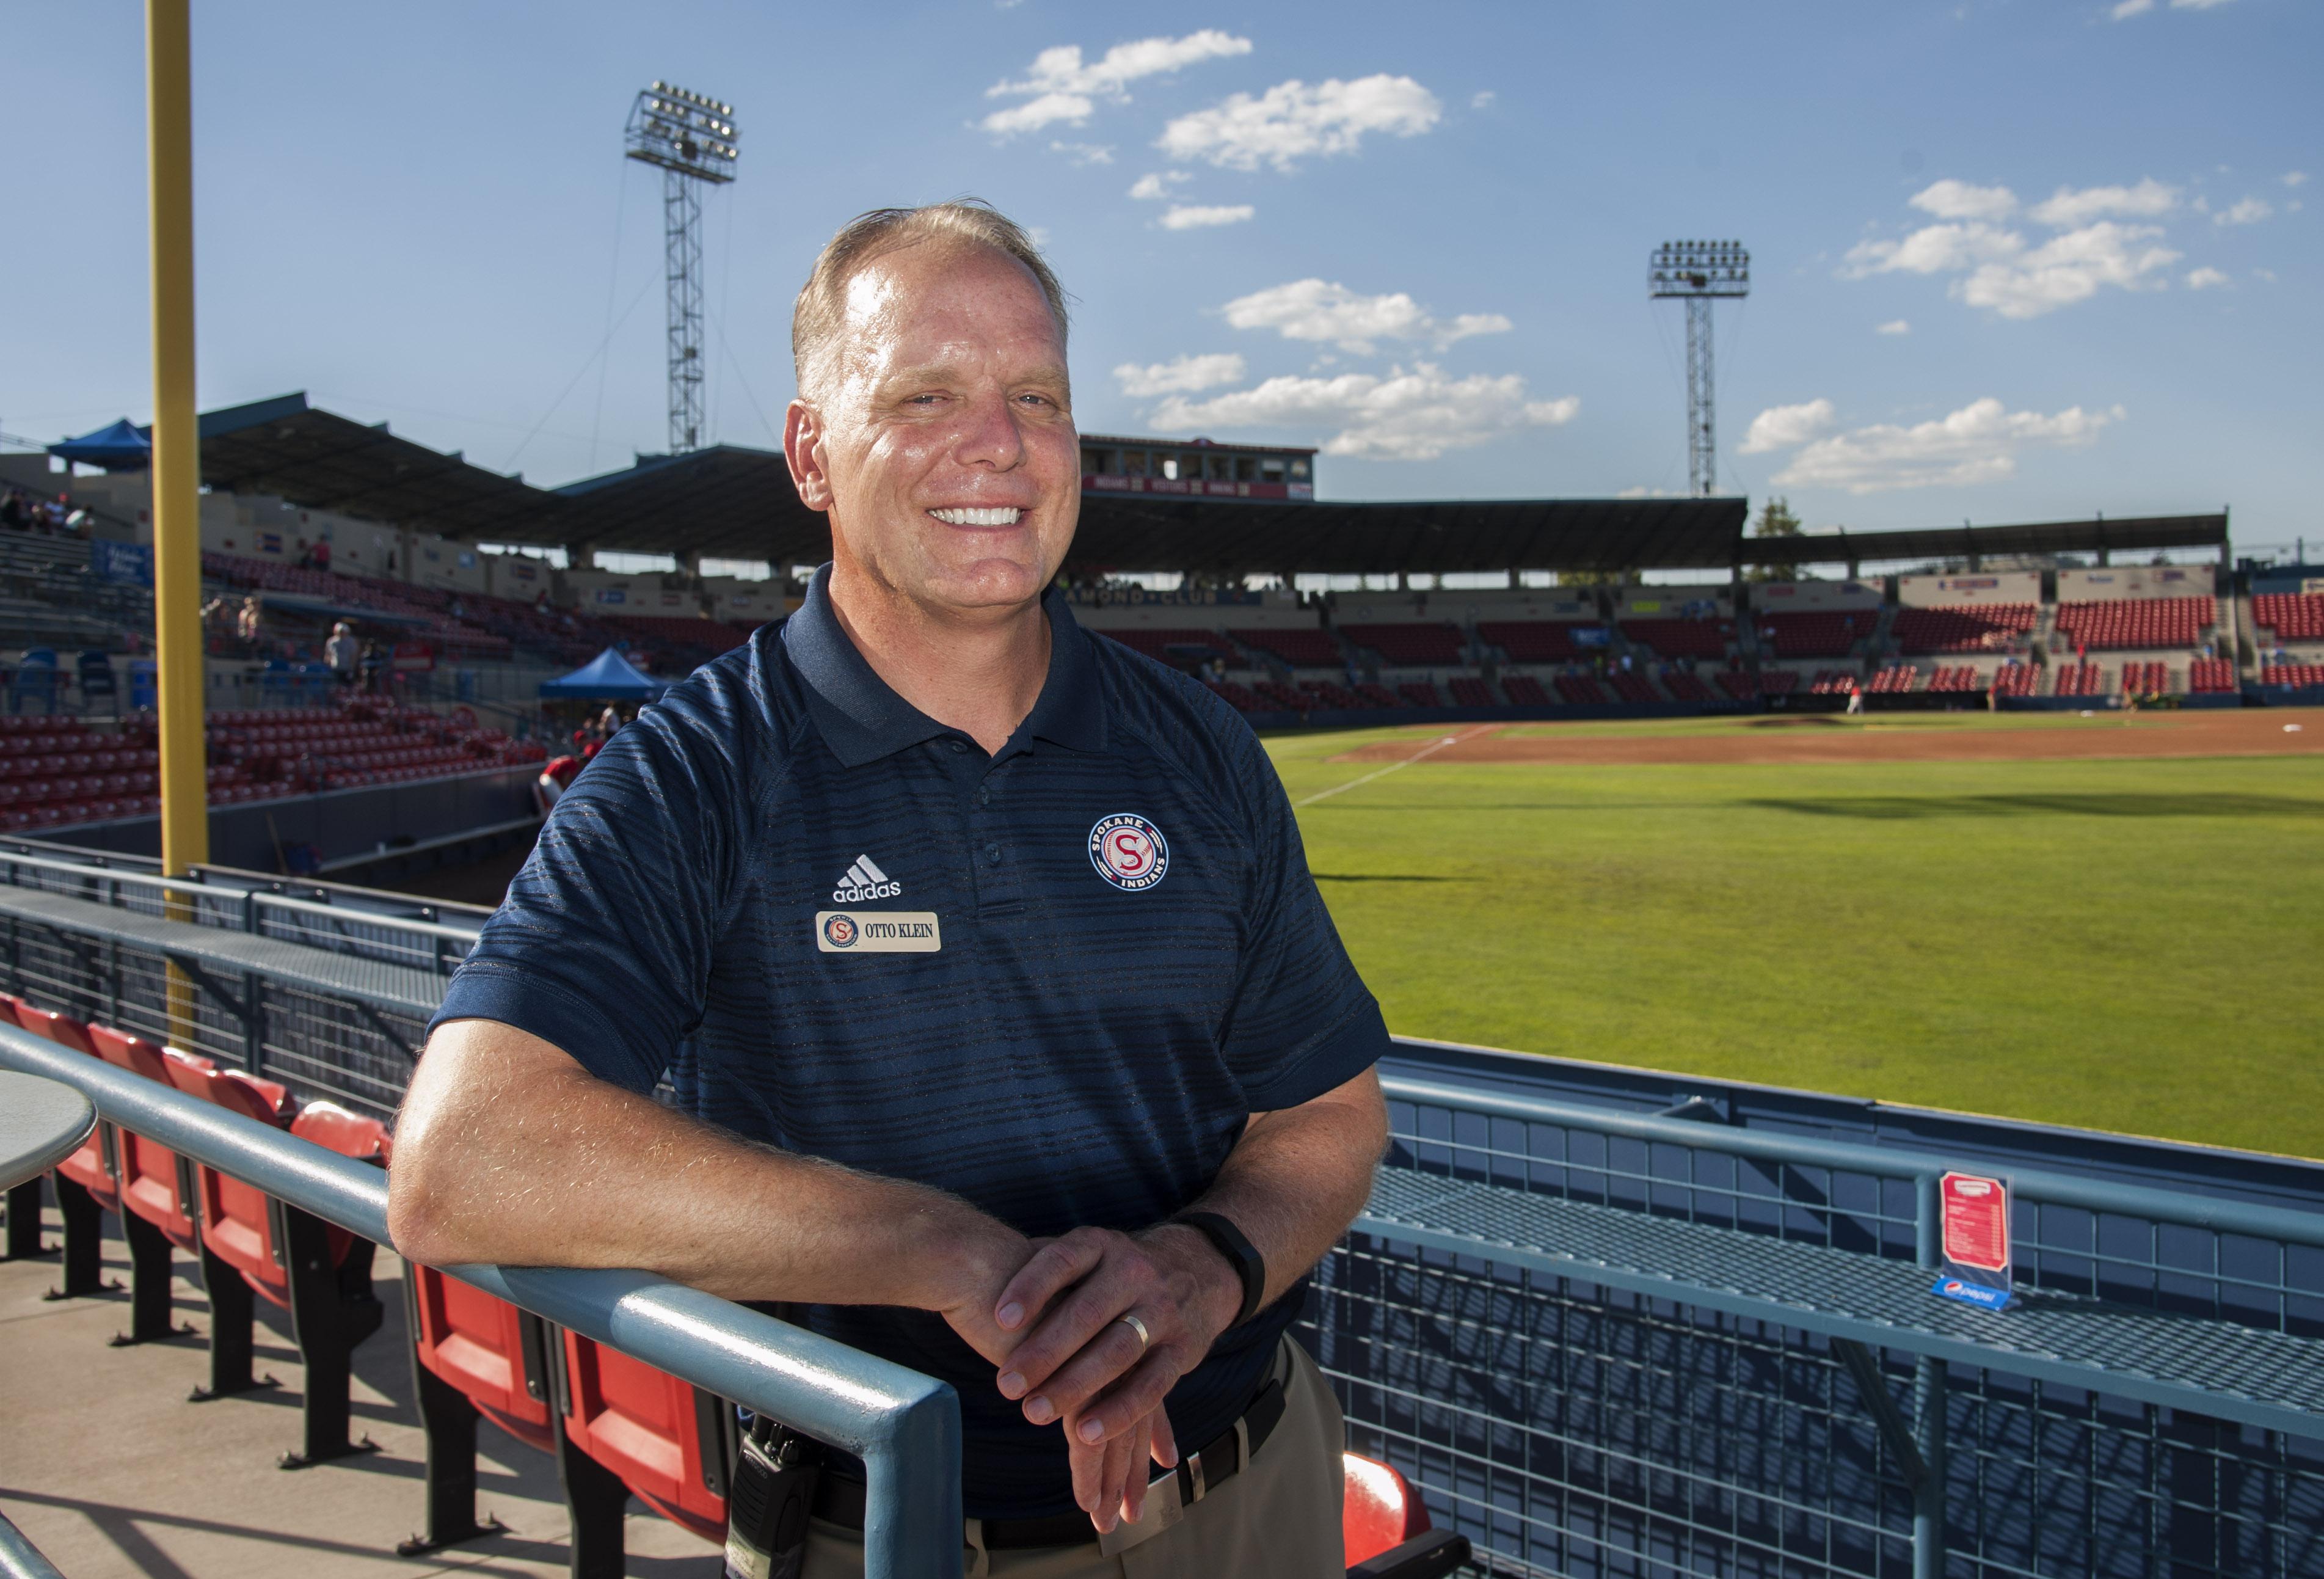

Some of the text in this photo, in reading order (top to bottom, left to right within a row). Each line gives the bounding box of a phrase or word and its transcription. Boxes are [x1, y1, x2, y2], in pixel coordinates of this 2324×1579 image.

[1091, 817, 1143, 851] SPOKANE
[1115, 834, 1140, 871] S
[1121, 857, 1165, 888] INDIANS
[832, 881, 902, 903] adidas
[865, 923, 933, 938] OTTO KLEIN
[1959, 1287, 1996, 1302] pepsi
